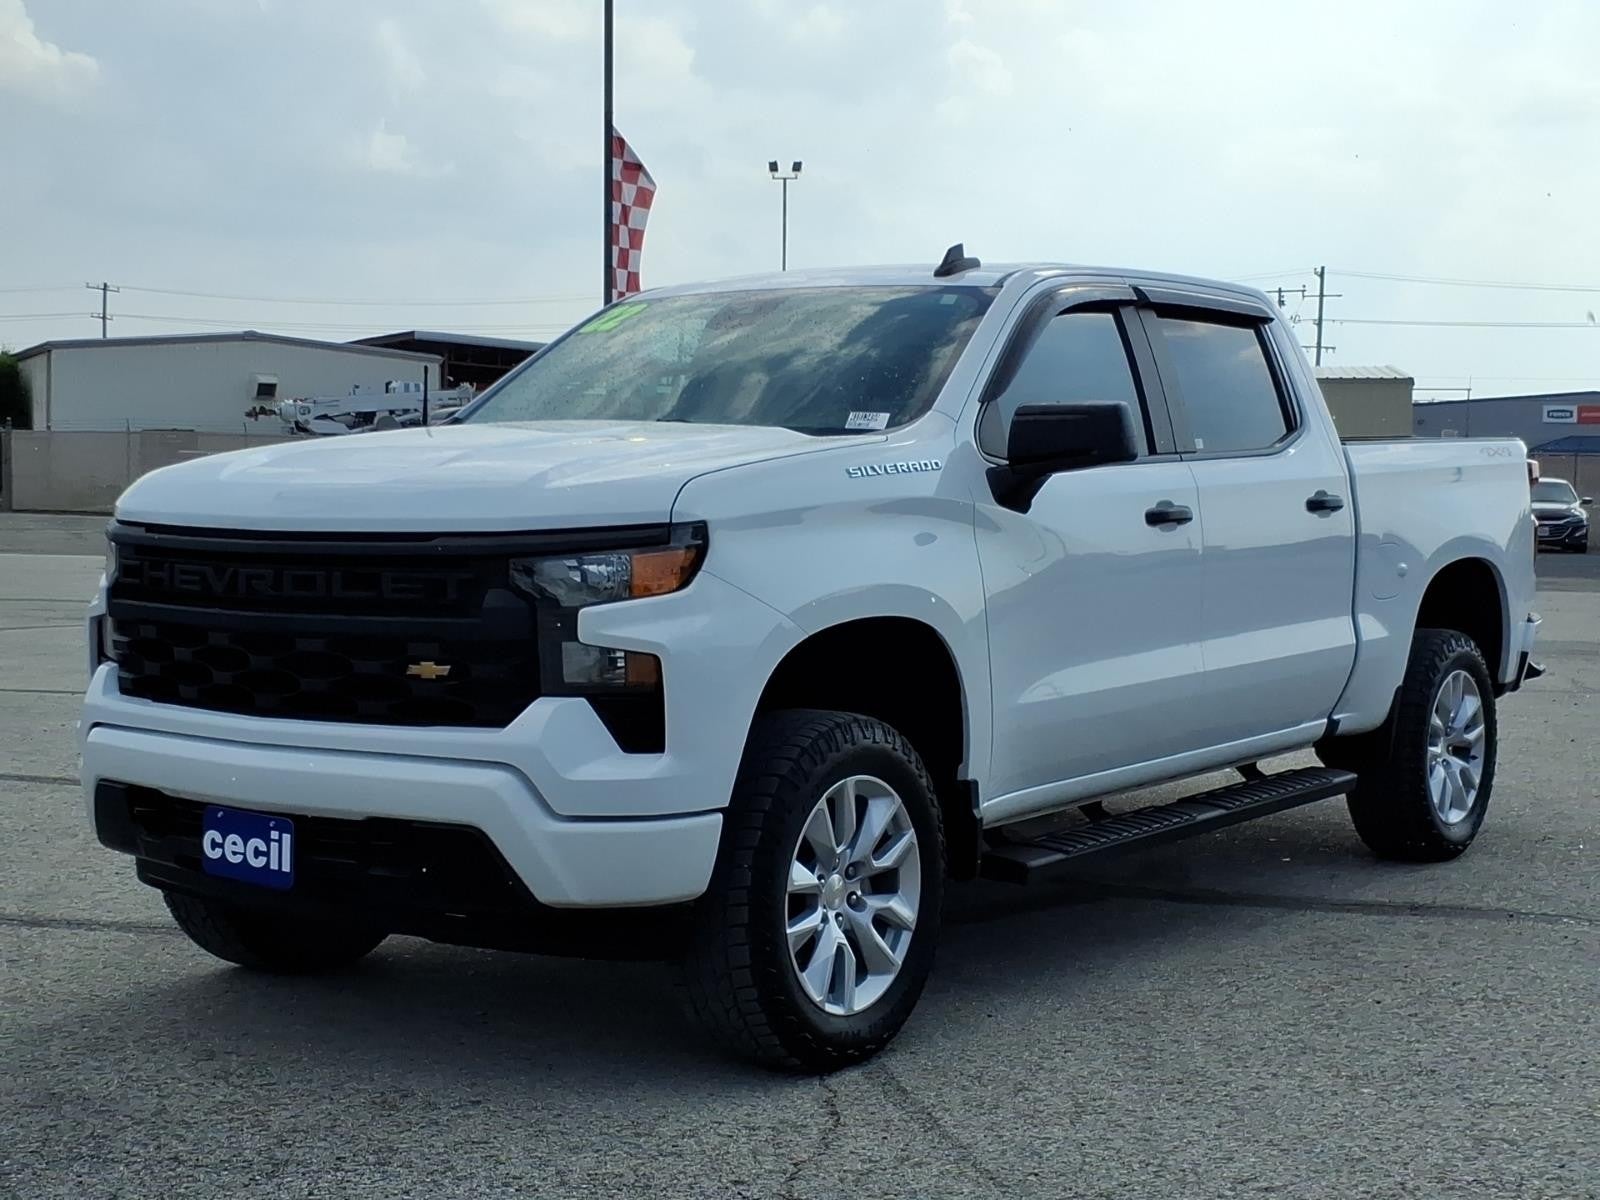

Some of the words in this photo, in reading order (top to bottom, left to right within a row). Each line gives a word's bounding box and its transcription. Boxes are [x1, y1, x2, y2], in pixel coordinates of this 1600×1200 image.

[846, 459, 942, 478] SILVERADO
[118, 558, 475, 600] CHEVROLET
[203, 829, 291, 873] cecil
